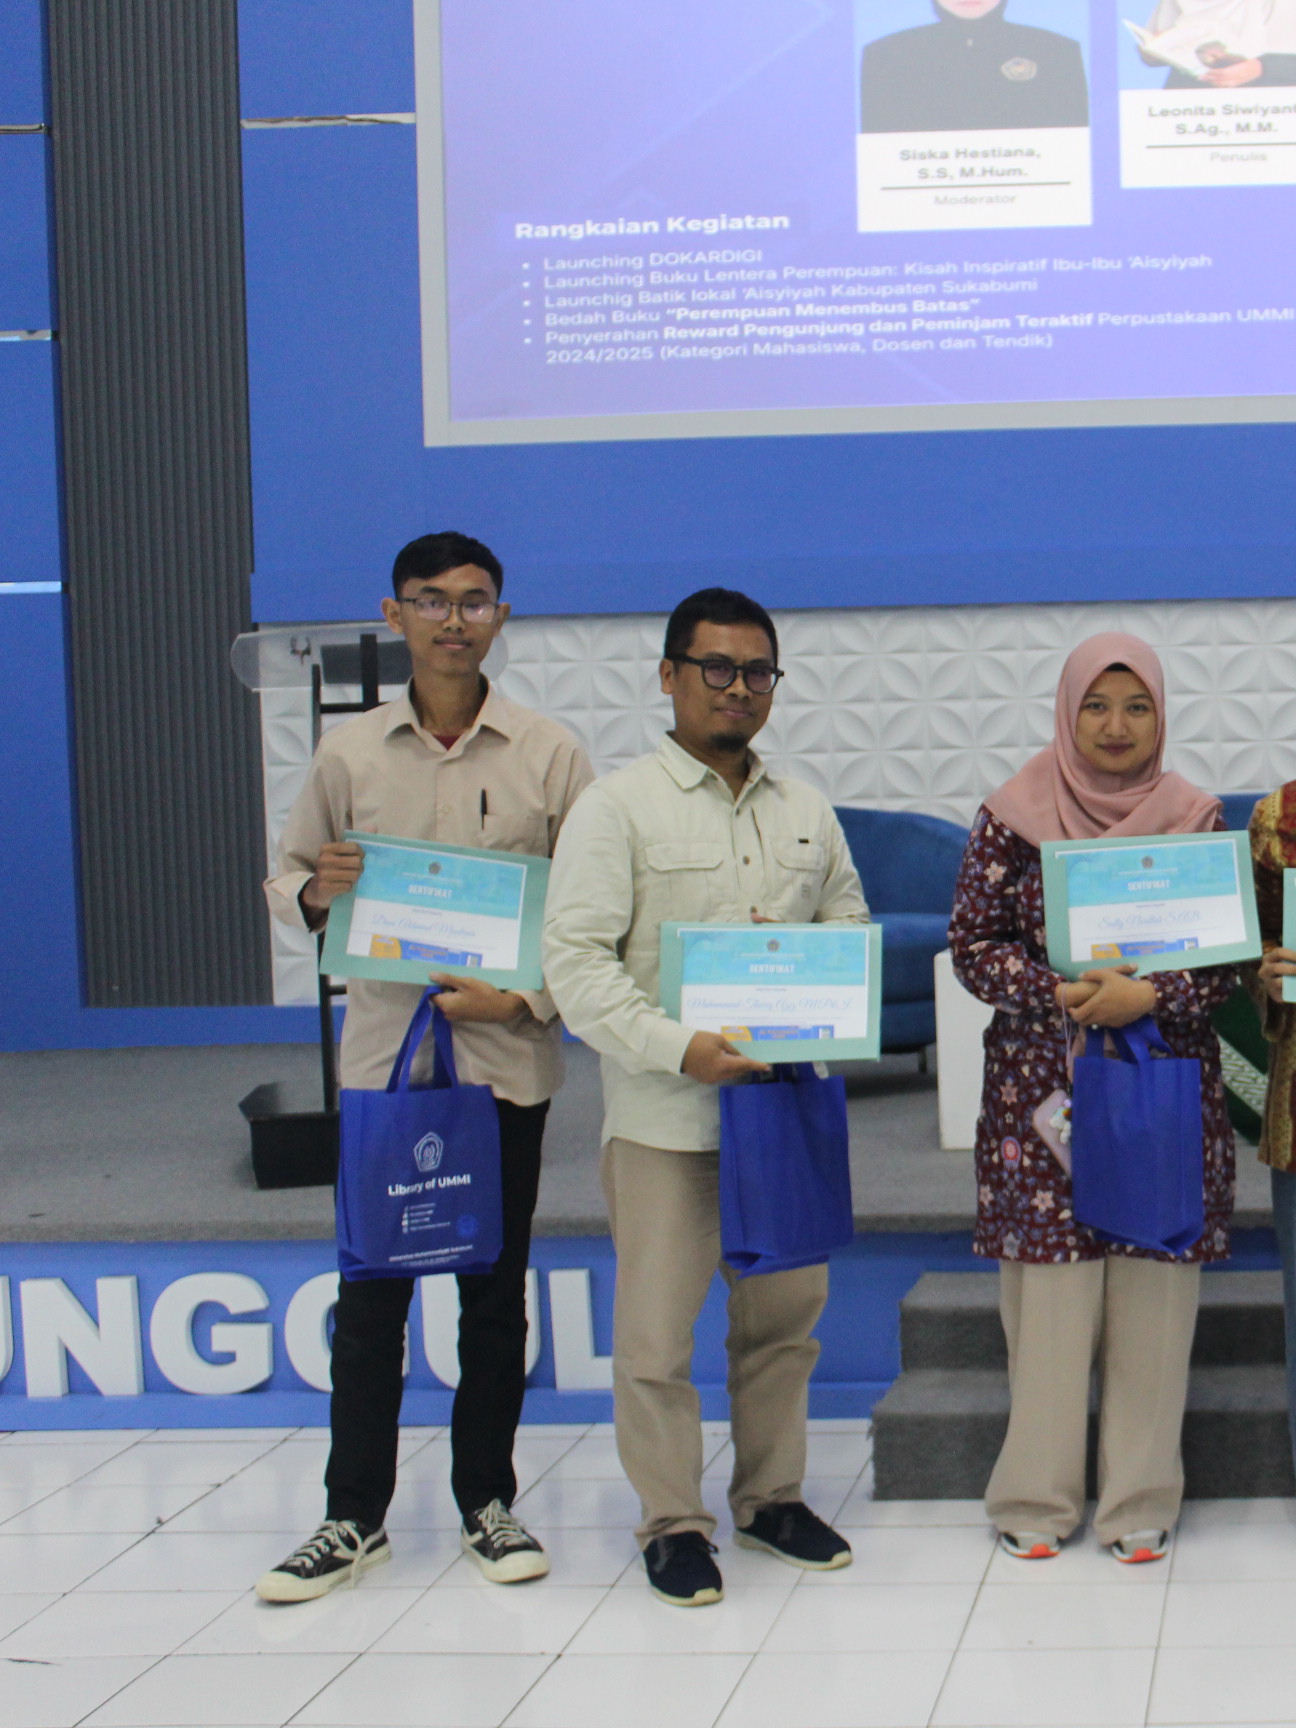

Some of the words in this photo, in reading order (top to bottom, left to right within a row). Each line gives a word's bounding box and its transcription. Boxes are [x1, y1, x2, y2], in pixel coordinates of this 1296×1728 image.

[1148, 103, 1217, 119] Leonita
[1236, 120, 1278, 135] M.M.
[899, 147, 950, 163] Siska
[954, 145, 1042, 162] Hestiana,
[1209, 149, 1268, 163] Penulis
[959, 163, 1029, 180] M.Hum.
[933, 191, 1018, 206] Moderator
[516, 218, 659, 240] Rangkaian
[667, 213, 790, 234] Kegiatan
[543, 253, 643, 271] Launching
[650, 249, 763, 267] DOKARDIGI
[544, 273, 644, 290] Launching
[650, 270, 699, 285] Buku
[704, 267, 777, 283] Lentera
[783, 264, 898, 283] Perempuan:
[904, 261, 957, 276] Kisah
[964, 257, 1048, 276] Inspiratif
[1053, 255, 1122, 271] Ibu-Ibu
[639, 289, 685, 304] Batik
[691, 286, 736, 301] lokal
[831, 281, 936, 299] Kabupaten
[942, 278, 1038, 294] Sukabumi
[545, 310, 606, 327] Bedah
[612, 308, 661, 323] Buku
[795, 300, 907, 318] Menembus
[545, 328, 659, 346] Penyerahan
[663, 324, 740, 340] Reward
[744, 320, 865, 340] Pengunjung
[869, 317, 902, 332] dan
[911, 314, 1011, 334] Peminjam
[1016, 312, 1095, 329] Teraktif
[1098, 308, 1232, 327] Perpustakaan
[1237, 307, 1296, 322] UMMI
[546, 346, 654, 364] 2024/2025
[659, 342, 749, 361] (Kategori
[754, 339, 866, 357] Mahasiswa,
[872, 336, 934, 353] Dosen
[939, 334, 976, 349] dan
[982, 332, 1054, 350] Tendik)
[388, 1182, 424, 1197] Library
[425, 1177, 436, 1190] of
[437, 1173, 471, 1188] UMMI
